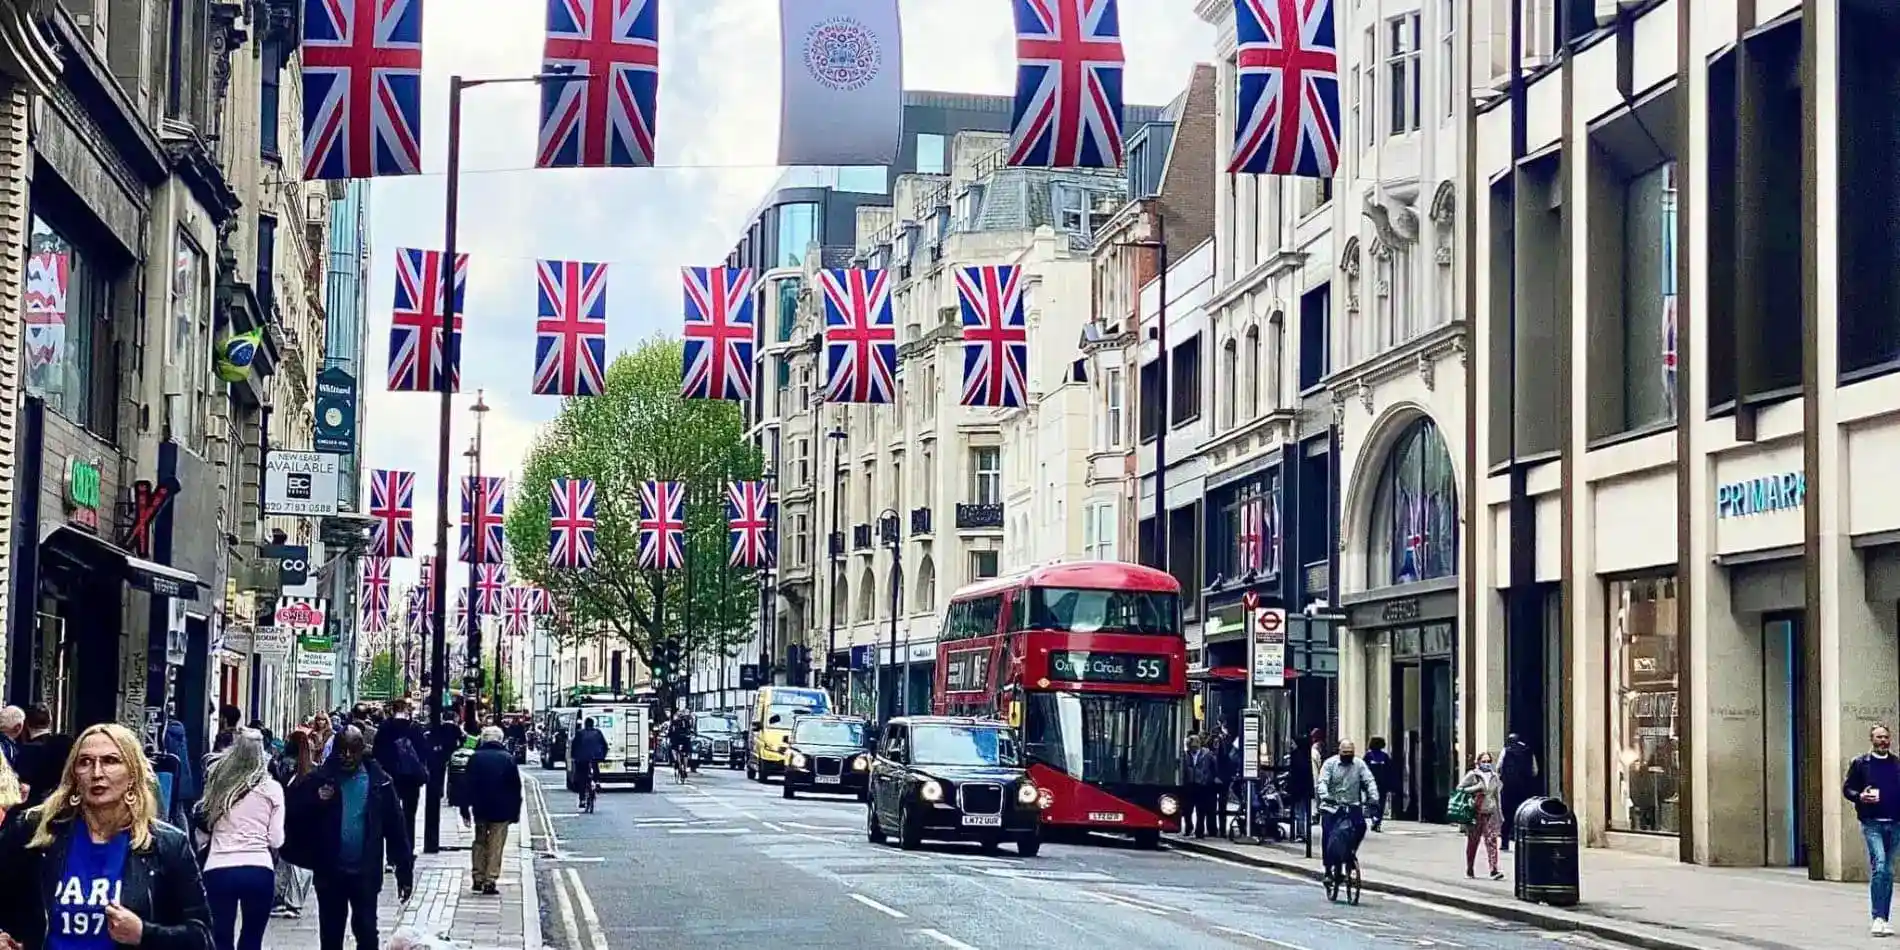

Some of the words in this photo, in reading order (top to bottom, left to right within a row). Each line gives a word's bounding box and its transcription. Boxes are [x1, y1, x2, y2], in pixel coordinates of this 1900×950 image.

[801, 42, 837, 91] CORONATION
[300, 454, 320, 462] LEASE
[267, 461, 333, 473] AVAILABLE
[266, 502, 281, 511] 020
[1055, 659, 1089, 673] Oxfd
[1093, 660, 1123, 674] Circus
[1136, 659, 1160, 678] 55
[62, 912, 105, 936] 197
